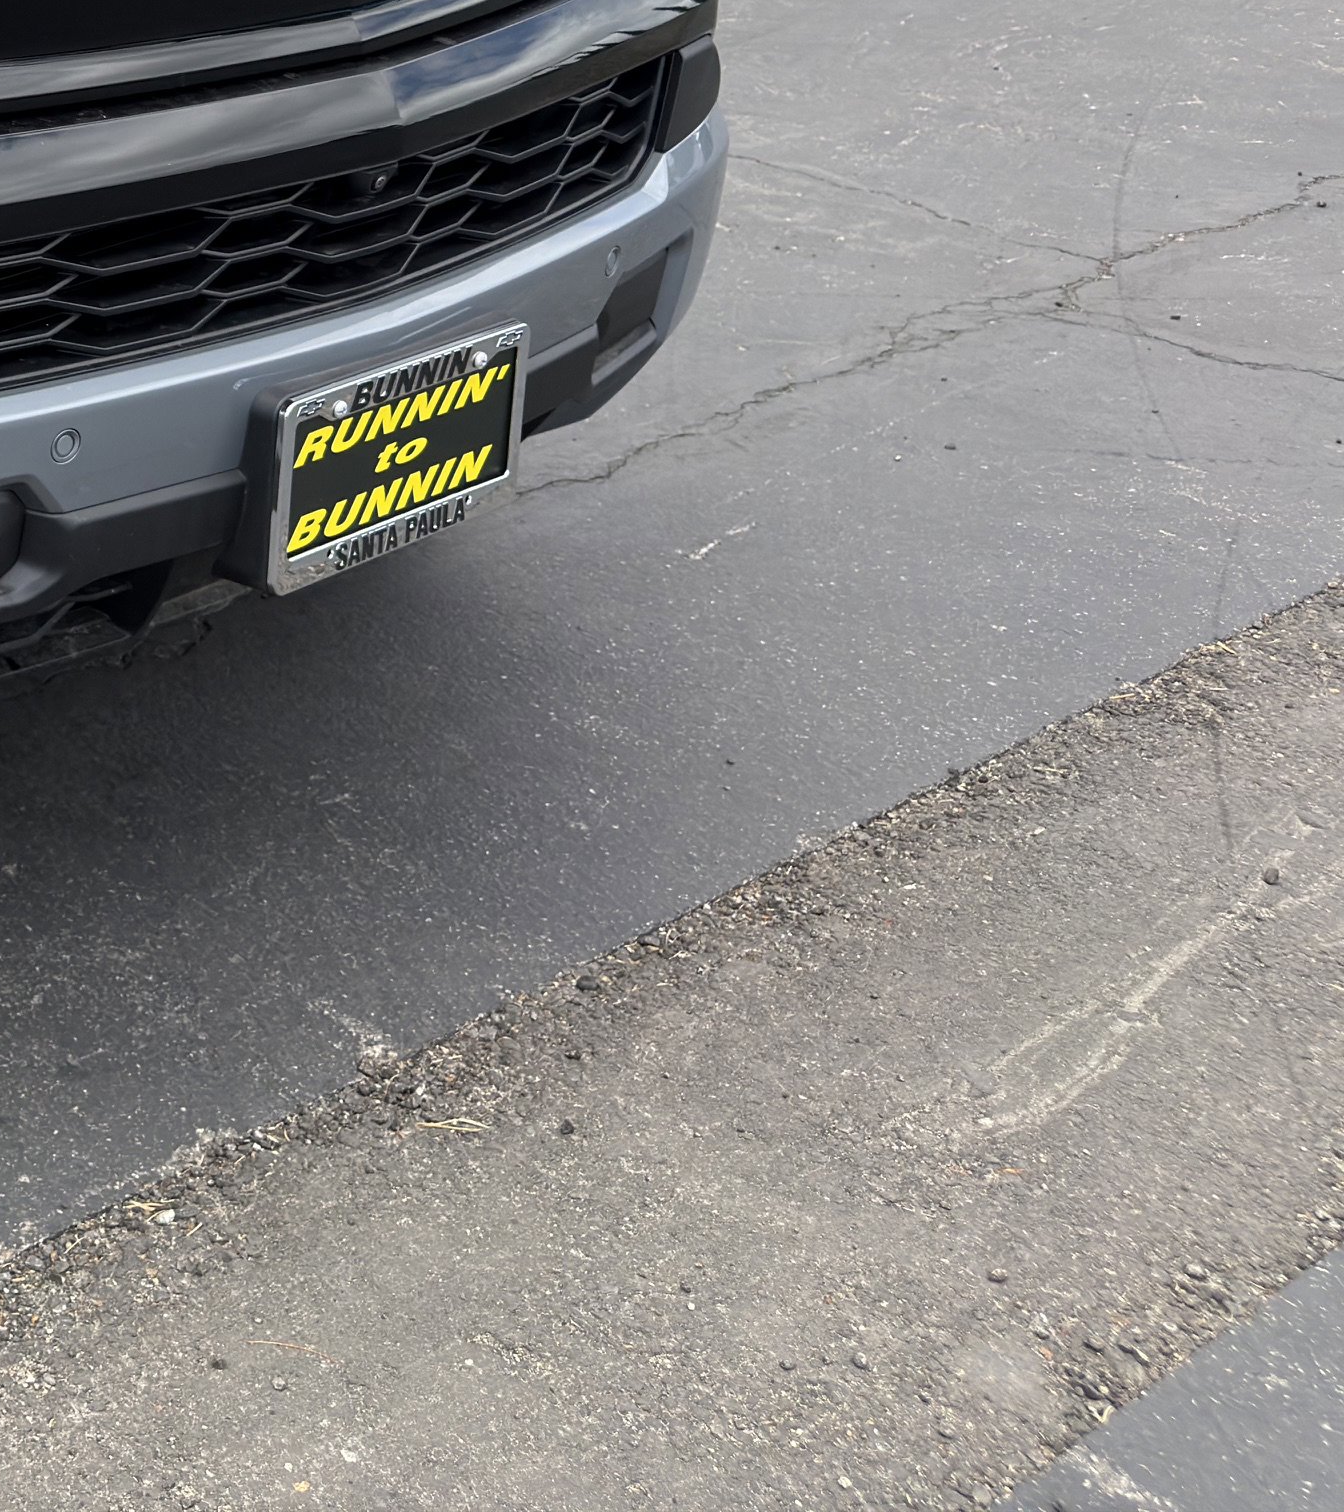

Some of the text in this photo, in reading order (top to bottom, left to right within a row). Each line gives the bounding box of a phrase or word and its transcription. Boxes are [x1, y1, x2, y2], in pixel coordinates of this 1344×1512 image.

[293, 363, 511, 469] RUNNIN'
[350, 345, 472, 413] BUNNIN
[374, 437, 429, 474] to
[286, 444, 493, 554] BUNNIN
[334, 496, 466, 571] SANTA PAULA
